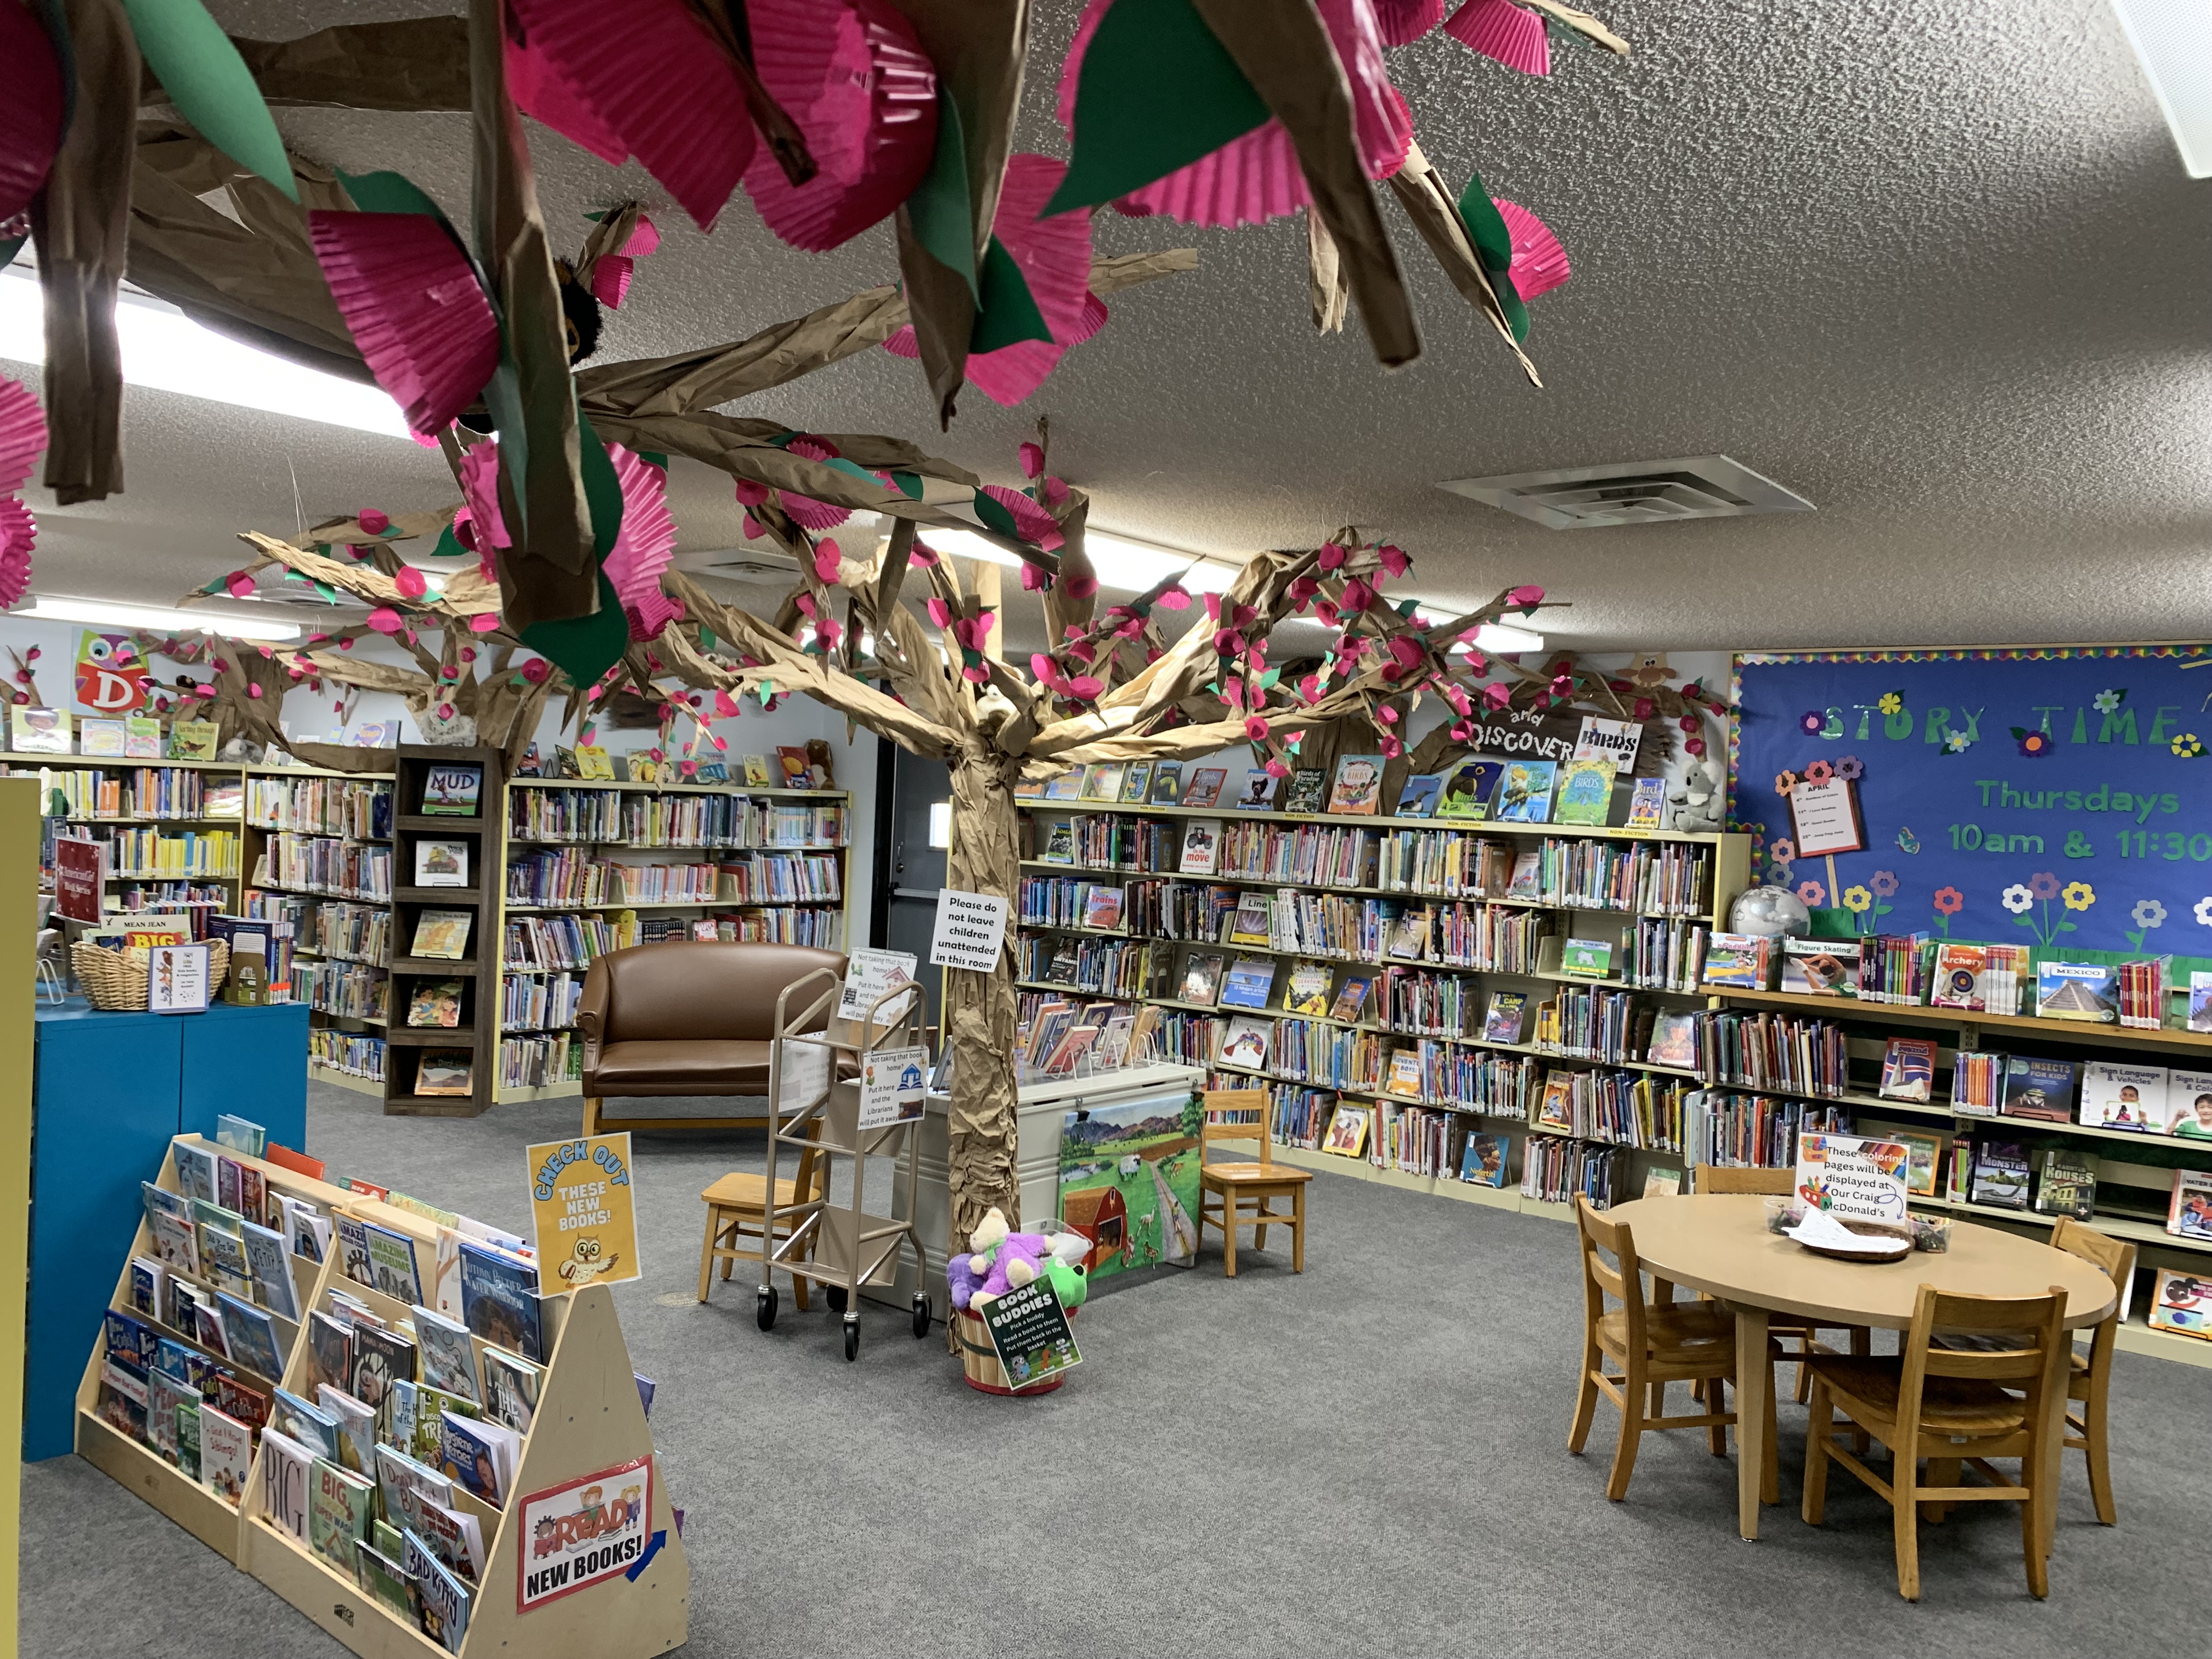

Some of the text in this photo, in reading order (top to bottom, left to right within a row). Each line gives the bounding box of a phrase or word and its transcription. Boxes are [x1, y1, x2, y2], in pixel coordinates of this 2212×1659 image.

[1510, 710, 1545, 727] and
[1819, 703, 2182, 746] STORY TIME
[1467, 725, 1573, 761] DISCOVER
[1581, 730, 1637, 752] BIRDS
[431, 774, 475, 790] MUD
[1347, 771, 1368, 780] BIRDS
[1575, 777, 1599, 788] BIRDS
[1633, 781, 1658, 796] Bird
[1808, 784, 1830, 792] APRIL
[1976, 779, 2180, 824] Thursdays
[1948, 823, 2212, 862] 10am & 11:30
[1187, 853, 1210, 862] move
[950, 898, 997, 912] Please do
[1091, 894, 1118, 905] Trains
[948, 913, 995, 926] not leave
[949, 927, 989, 940] children
[133, 934, 177, 948] BIG
[938, 941, 996, 955] unattended
[868, 955, 884, 966] taking
[896, 959, 910, 967] book
[936, 953, 992, 969] in this room
[1942, 955, 1983, 969] Archery
[873, 966, 890, 974] home?
[2056, 967, 2101, 977] MEXICO
[872, 983, 885, 991] here
[856, 1011, 865, 1019] put
[881, 1054, 897, 1064] taking
[886, 1063, 904, 1072] home?
[2030, 1061, 2071, 1074] INSECTS
[2100, 1067, 2160, 1080] Sign Language
[2117, 1076, 2151, 1085] Vehicles
[2176, 1075, 2194, 1084] Sign
[867, 1105, 893, 1115] Librarians
[870, 1118, 880, 1127] put
[884, 1115, 899, 1124] away
[1827, 1147, 1905, 1166] These coloring
[534, 1141, 629, 1201] CHECK OUT
[1824, 1161, 1891, 1176] pages will be
[1981, 1157, 2028, 1171] MONSTER
[1470, 1167, 1496, 1179] Nefertiti
[2045, 1166, 2094, 1184] HOUSES
[1826, 1174, 1876, 1188] displayed
[558, 1181, 606, 1201] THESE
[1831, 1188, 1880, 1204] Our Craig
[566, 1197, 600, 1215] NEW
[1824, 1200, 1885, 1217] McDonald's
[558, 1209, 611, 1232] BOOKS!
[371, 1250, 410, 1274] MUSEUMS
[997, 1284, 1037, 1310] BOOK
[991, 1293, 1053, 1327] BUDDIES
[1010, 1321, 1022, 1330] Pick
[1027, 1312, 1045, 1324] buddy
[1003, 1333, 1018, 1344] Read
[1023, 1325, 1036, 1336] book
[1044, 1317, 1059, 1328] them
[1006, 1344, 1017, 1352] Put
[1017, 1338, 1031, 1348] them
[1032, 1332, 1046, 1342] back
[1052, 1325, 1062, 1334] the
[1027, 1340, 1047, 1351] basket
[495, 1381, 518, 1415] THE
[402, 1402, 411, 1412] The
[397, 1414, 403, 1424] of
[322, 1470, 346, 1506] BIG
[554, 1499, 628, 1552] READ
[409, 1546, 430, 1580] BAD
[527, 1534, 642, 1598] NEW BOOKS!
